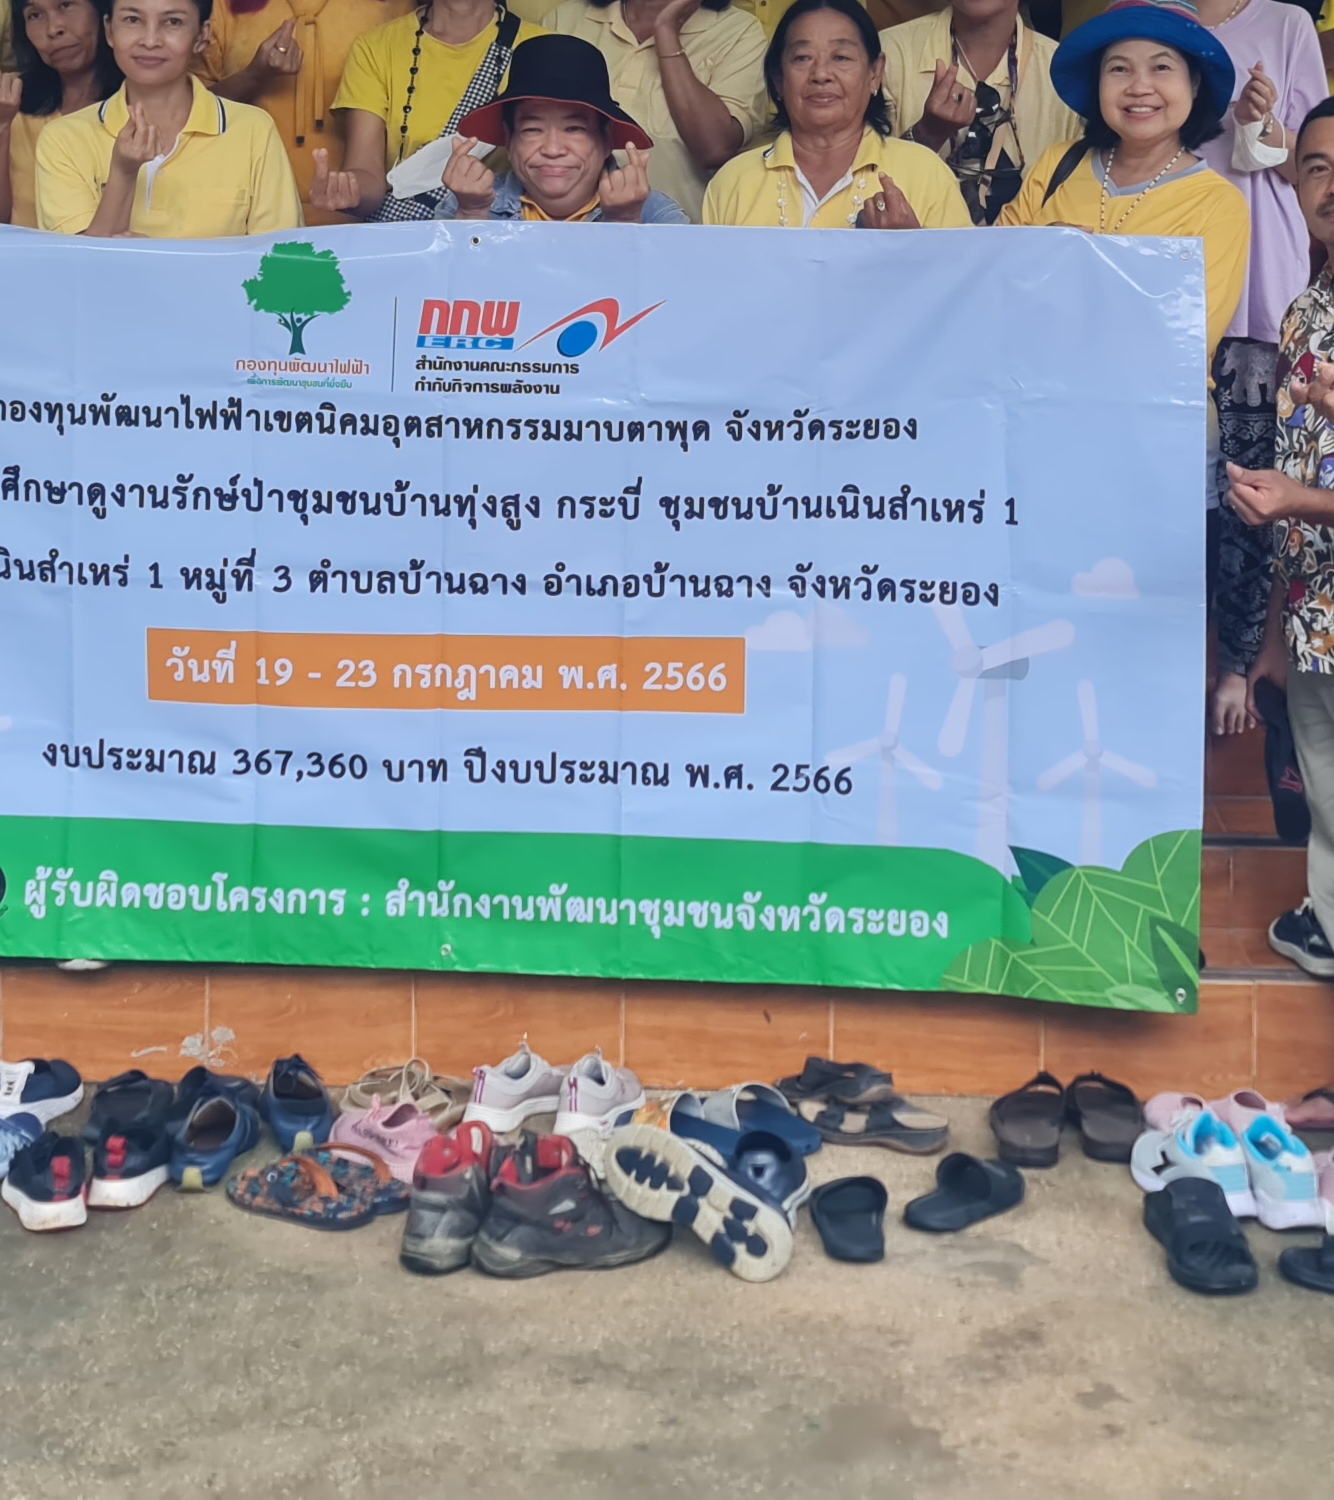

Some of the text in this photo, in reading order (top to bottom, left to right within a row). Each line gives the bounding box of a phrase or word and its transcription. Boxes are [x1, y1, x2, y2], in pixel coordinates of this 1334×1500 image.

[418, 299, 520, 336] กกพ
[424, 336, 503, 349] ERC
[235, 357, 370, 376] กองทุนพัฒนาไฟฟ้า
[415, 355, 580, 374] สำนักงานคณะกรรมการ
[414, 376, 560, 395] กำกับกิจการพลังงาน
[724, 407, 919, 444] จังหวัดระยอง
[556, 476, 644, 522] กระบี่
[657, 482, 987, 533] ชุมชนบ้านเนินสำเหร่
[1004, 497, 1020, 527] 1
[147, 561, 164, 590] 1
[179, 547, 258, 605] หมู่ที่
[272, 565, 293, 594] 3
[307, 558, 528, 597] ตำบลบ้านฉาง
[542, 561, 772, 599] อำเภอบ้านฉาง
[786, 562, 1001, 608] จังหวัดระยอง
[164, 640, 237, 686] วันที่
[253, 657, 294, 688] 19
[335, 658, 378, 689] 23
[391, 660, 544, 702] กรกฎาคม
[557, 662, 628, 693] พ.ศ.
[641, 661, 728, 693] 2566
[41, 738, 854, 796] งบประมาณ 367,360 บาท ปีงบประมาณ พ.ศ. 2566
[22, 864, 348, 920] ผู้รับผิดชอบโครงการ
[384, 878, 951, 941] สำนักงานพัฒนาชุมชนจังหวัดระยอง
